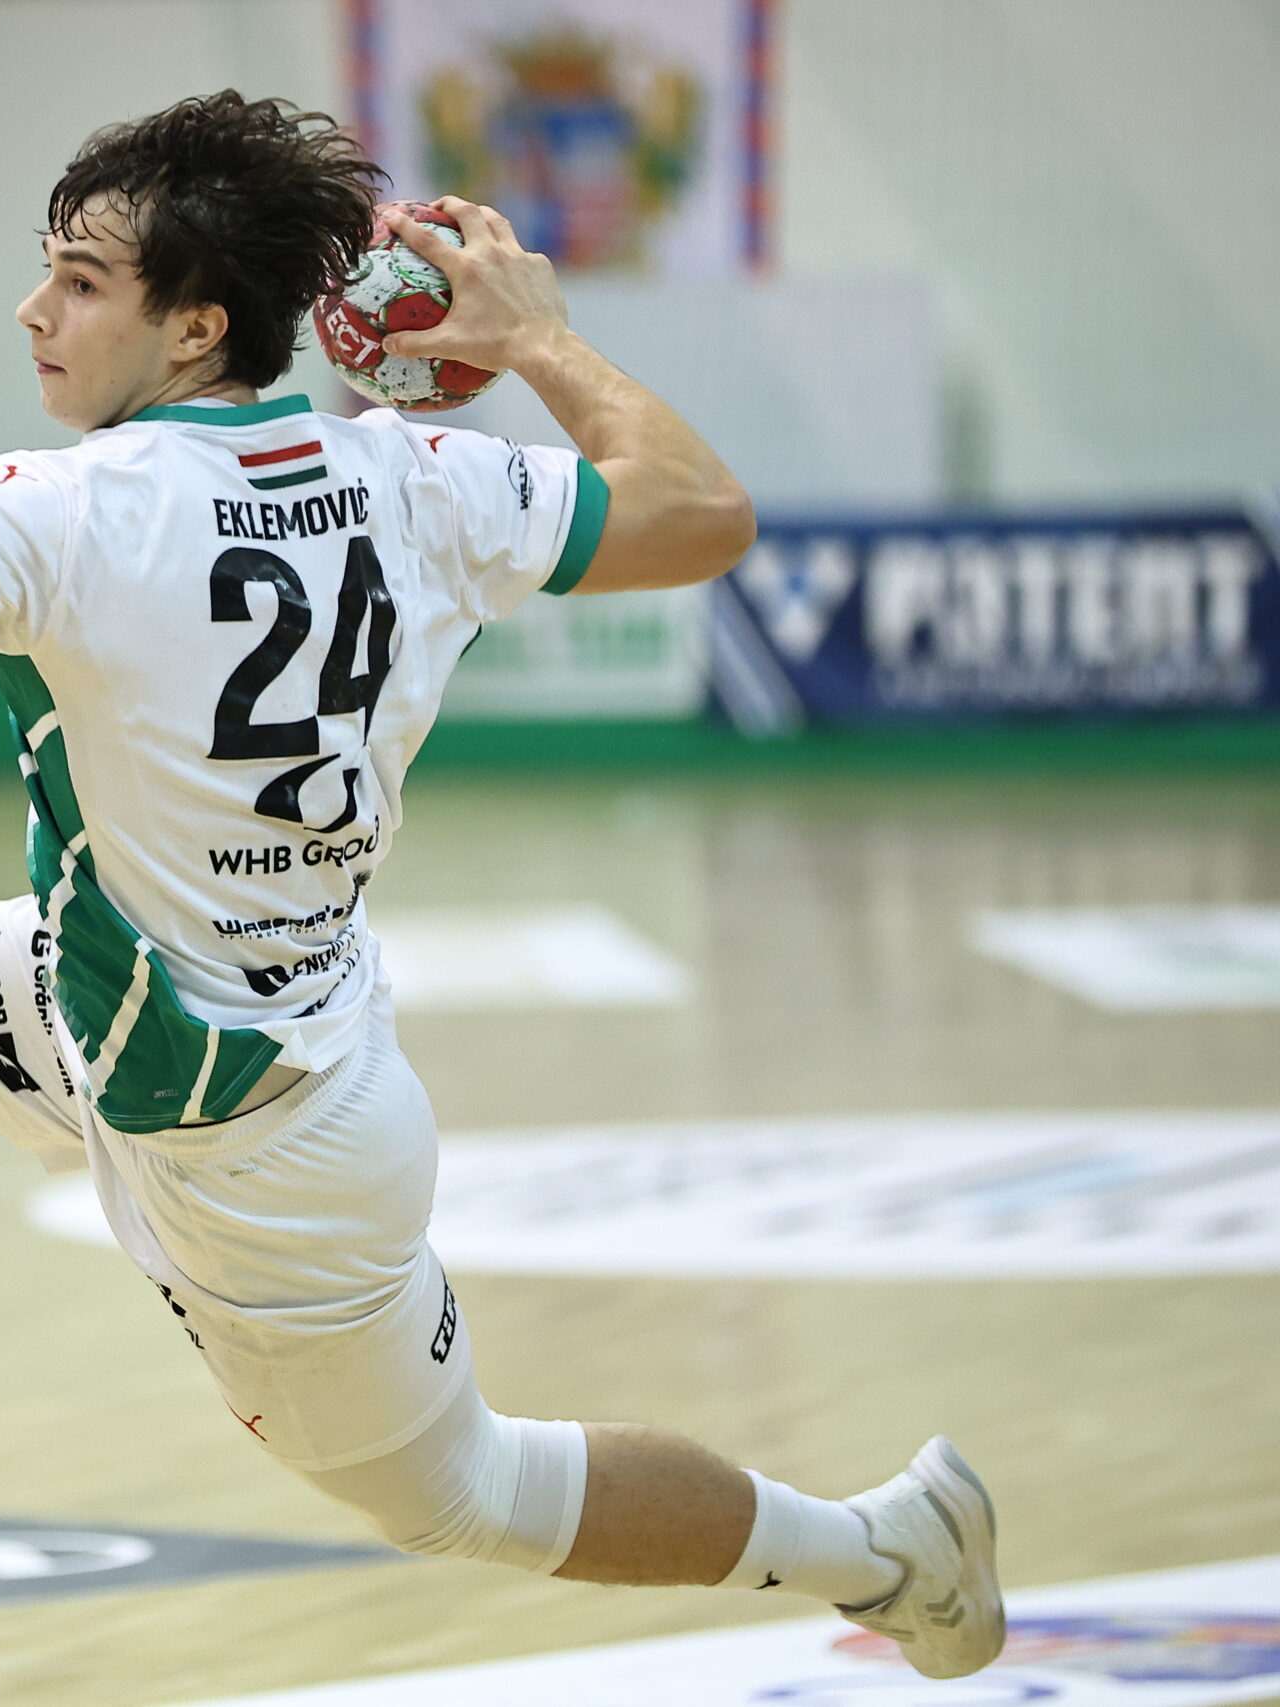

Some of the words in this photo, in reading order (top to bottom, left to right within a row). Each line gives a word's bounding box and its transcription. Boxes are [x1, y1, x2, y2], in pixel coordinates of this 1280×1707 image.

[211, 477, 370, 541] EKLEMOVIĆ
[207, 535, 397, 760] 24
[209, 845, 292, 875] WHB
[302, 814, 380, 868] GROU
